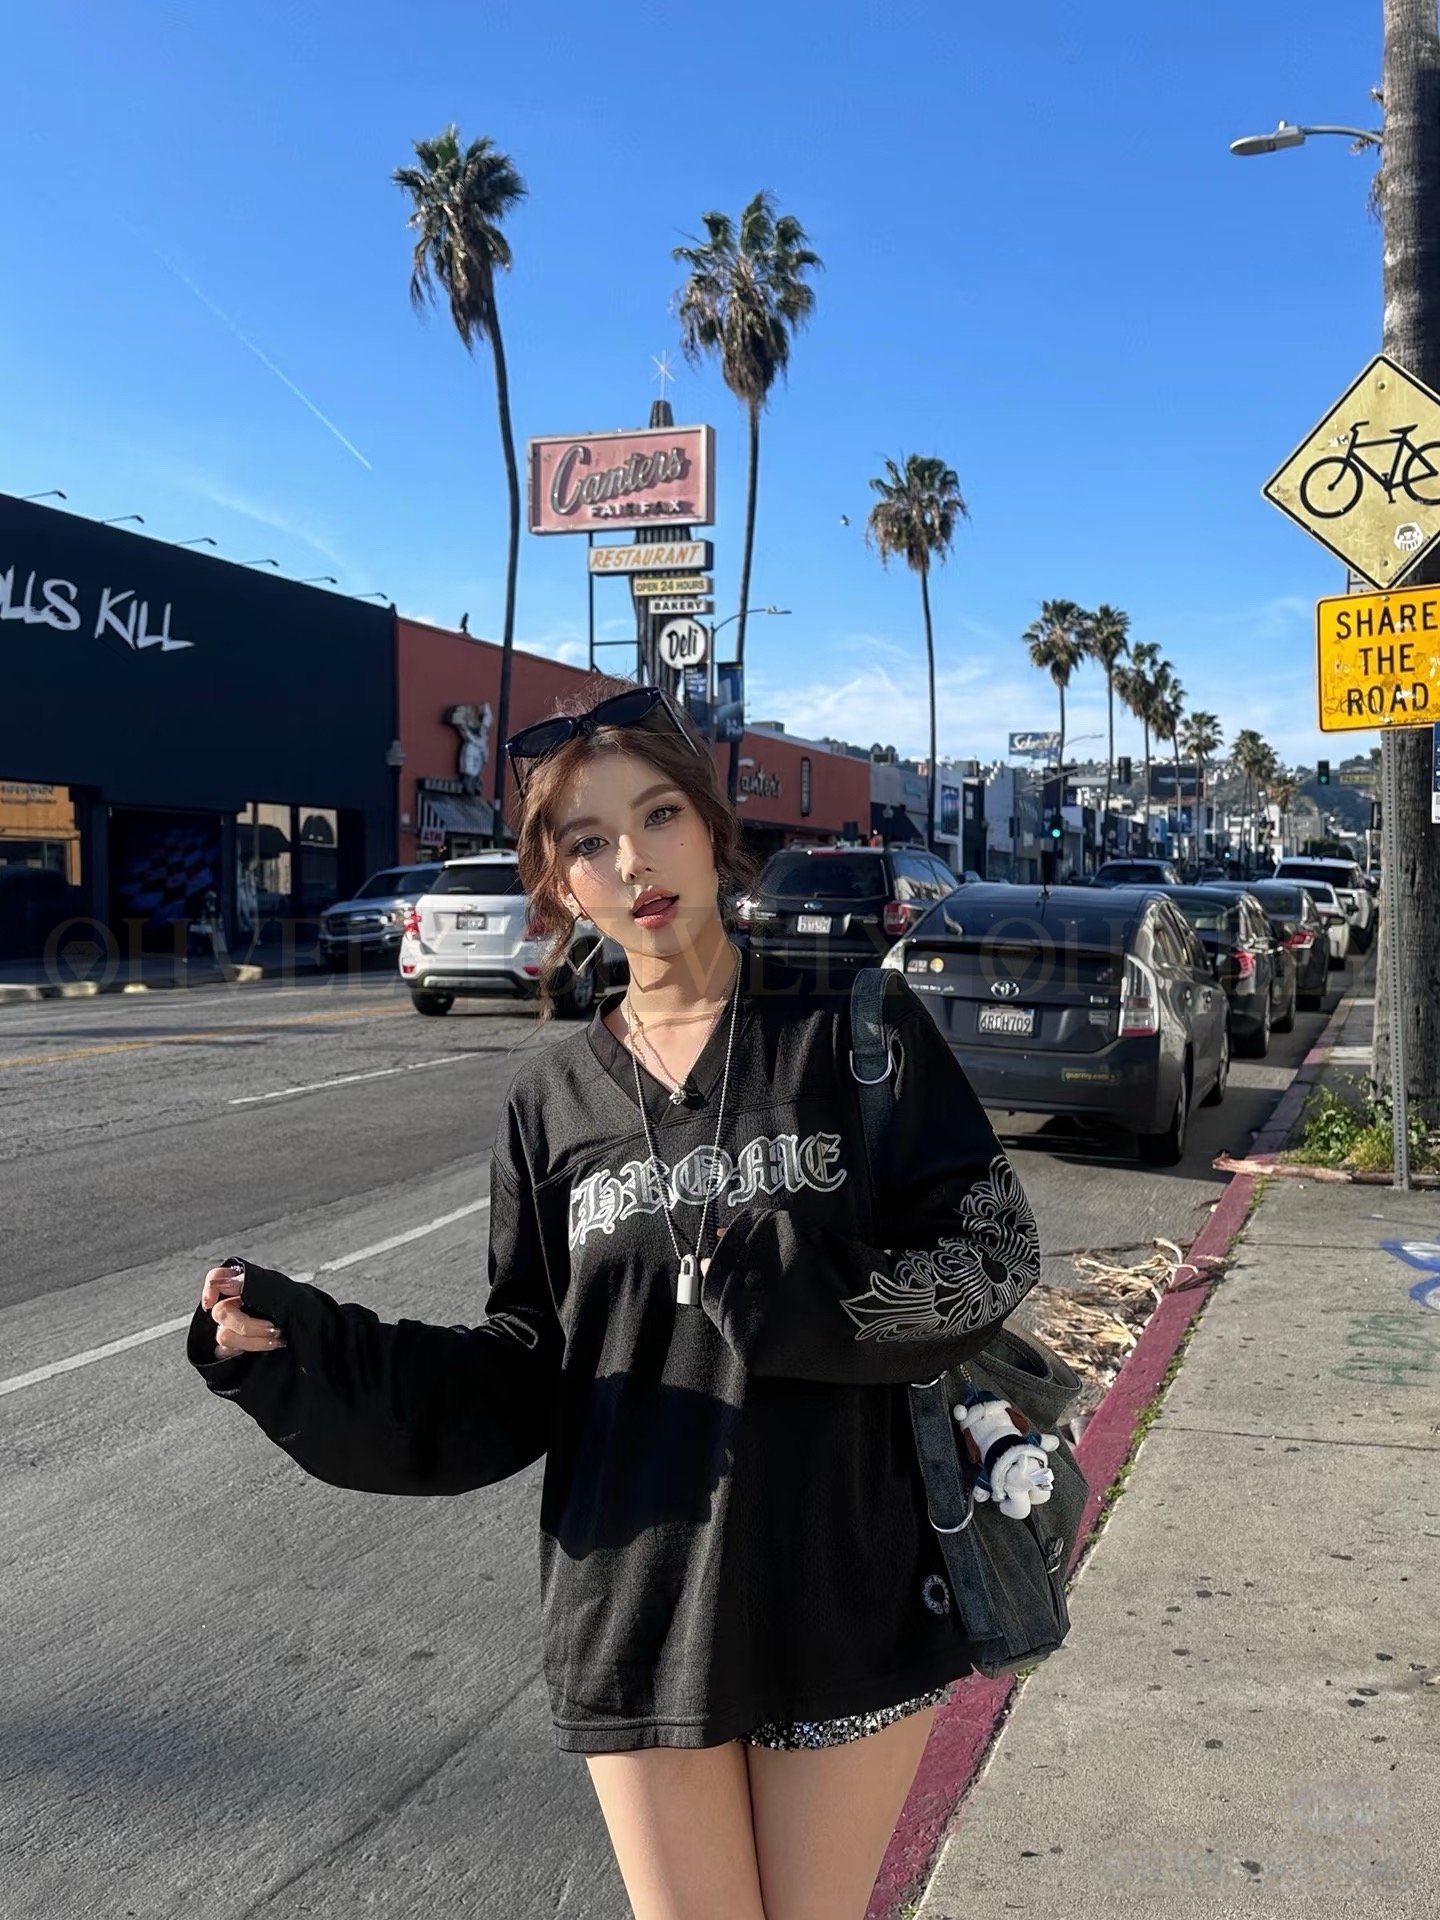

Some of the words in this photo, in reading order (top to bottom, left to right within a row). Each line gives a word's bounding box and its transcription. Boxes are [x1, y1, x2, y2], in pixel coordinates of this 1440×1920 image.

[592, 545, 701, 568] RESTAURANT
[636, 582, 658, 592] OPEN
[660, 580, 674, 592] 24
[675, 580, 705, 590] HOURS
[0, 565, 81, 631] LLS
[94, 586, 196, 652] KILL
[654, 601, 703, 611] BAKERY
[1336, 601, 1439, 640] SHARE
[667, 628, 699, 661] Deli
[1358, 643, 1416, 676] THE
[1347, 682, 1429, 717] ROAD
